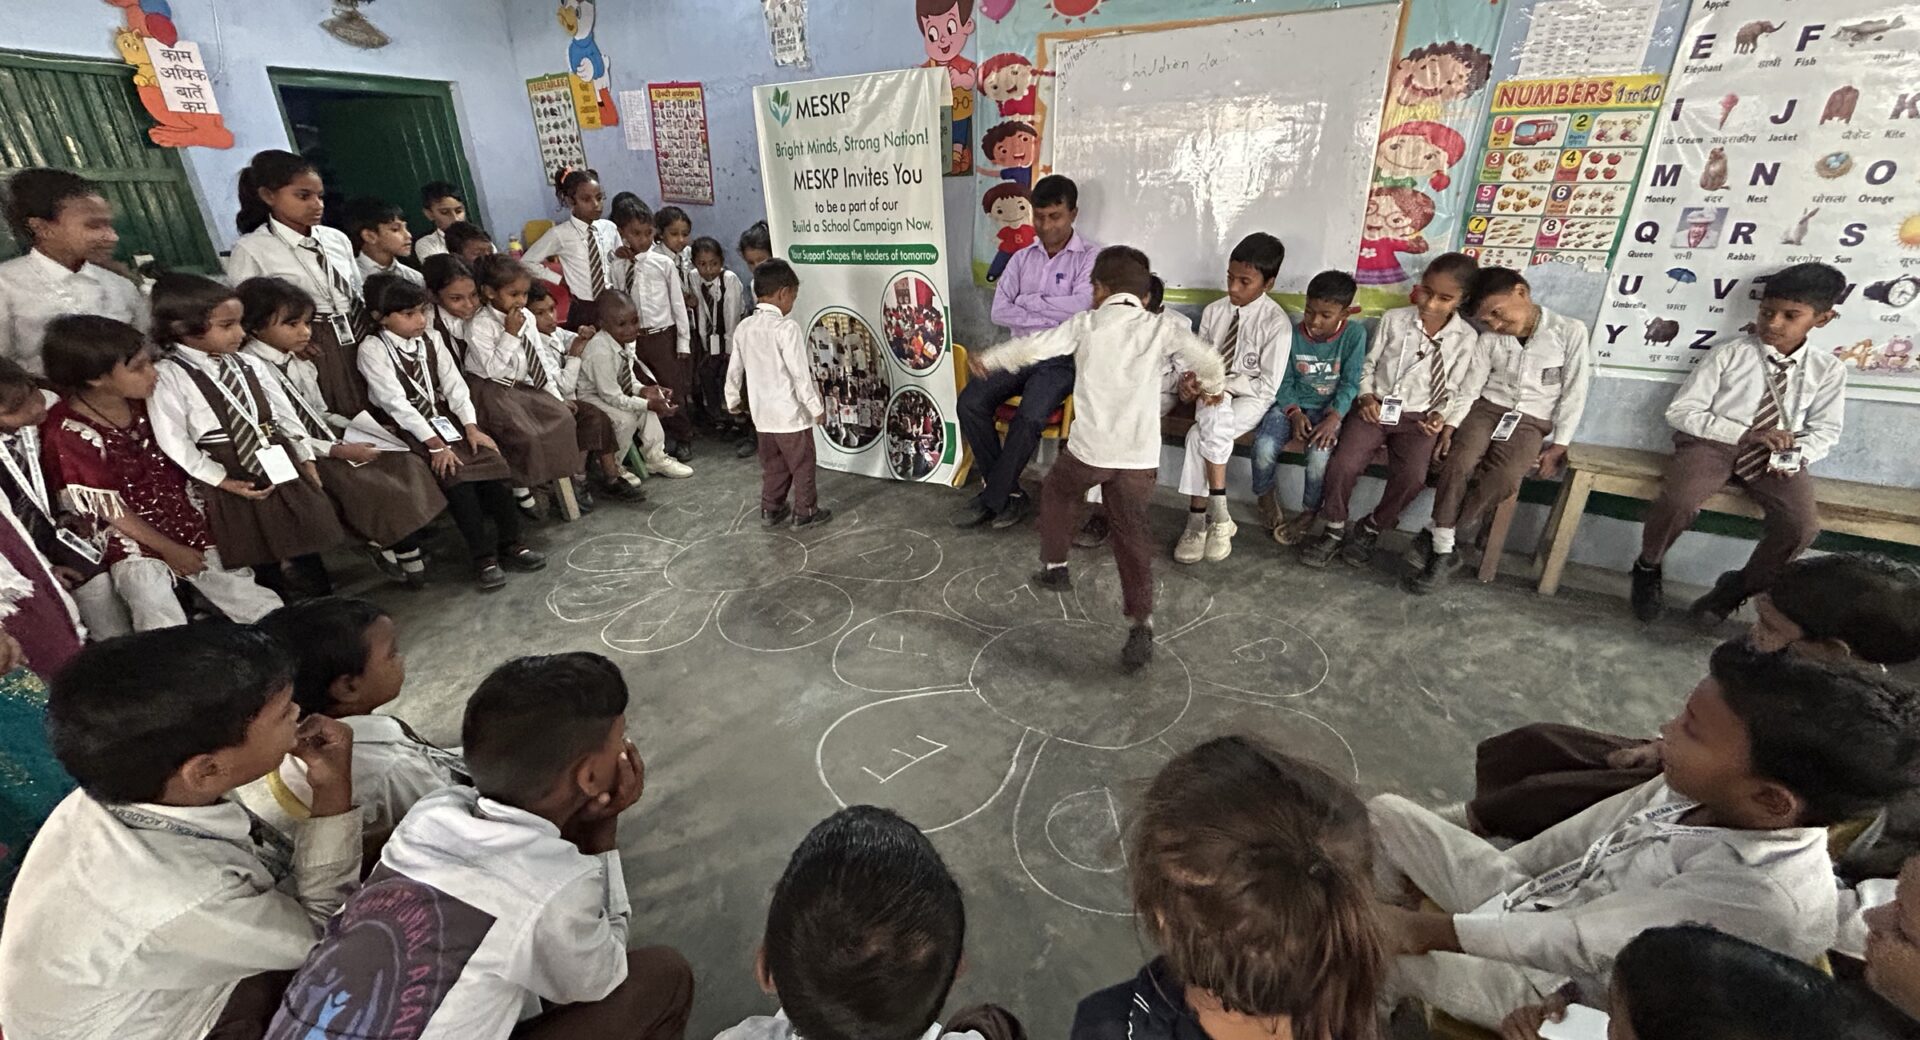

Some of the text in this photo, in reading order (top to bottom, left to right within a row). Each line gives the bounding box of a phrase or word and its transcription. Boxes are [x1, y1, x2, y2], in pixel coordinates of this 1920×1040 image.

[1795, 24, 1826, 52] F
[1689, 33, 1717, 59] E
[160, 49, 191, 63] काम
[1794, 57, 1817, 67] Fish
[160, 67, 206, 81] अधिक
[1684, 64, 1723, 74] Elephant
[174, 83, 203, 100] बातें
[1498, 82, 1614, 107] NUMBERS
[1616, 86, 1625, 102] 1
[1641, 85, 1661, 102] 10
[180, 101, 207, 113] कम
[796, 92, 850, 119] MESKP
[1671, 98, 1685, 121] I
[1769, 99, 1798, 125] J
[1889, 93, 1920, 119] K
[1499, 116, 1507, 129] 1
[1576, 115, 1588, 127] 2
[776, 128, 929, 160] Bright Minds, Strong Nation!
[1677, 136, 1703, 144] Cream
[1768, 134, 1798, 142] Jacket
[1490, 152, 1501, 164] 3
[1565, 151, 1577, 163] 4
[794, 163, 922, 191] MESKP Invites You
[1650, 164, 1682, 187] M
[1749, 162, 1781, 186] N
[1865, 160, 1897, 185] O
[1481, 185, 1492, 197] 5
[1556, 187, 1567, 199] 6
[815, 197, 898, 214] to be a part of our
[1645, 195, 1676, 205] Monkey
[1747, 195, 1768, 203] Nest
[1858, 194, 1894, 205] Orange
[792, 218, 933, 235] Build a School Campaign Now.
[1474, 218, 1484, 230] 7
[1547, 219, 1557, 231] 8
[1635, 221, 1660, 244] Q
[1728, 222, 1757, 245] R
[1839, 223, 1867, 247] S
[791, 249, 936, 262] Your Support Shapes the leaders of tomorrow
[1627, 250, 1653, 259] Queen
[1727, 253, 1756, 261] Rabbit
[1834, 255, 1852, 263] Sun
[1618, 275, 1644, 296] U
[1713, 278, 1739, 299] V
[1612, 301, 1647, 309] Umbrella
[1708, 305, 1724, 313] Van
[1605, 324, 1628, 344] Y
[1688, 329, 1717, 350] Z
[1597, 350, 1611, 358] Yak
